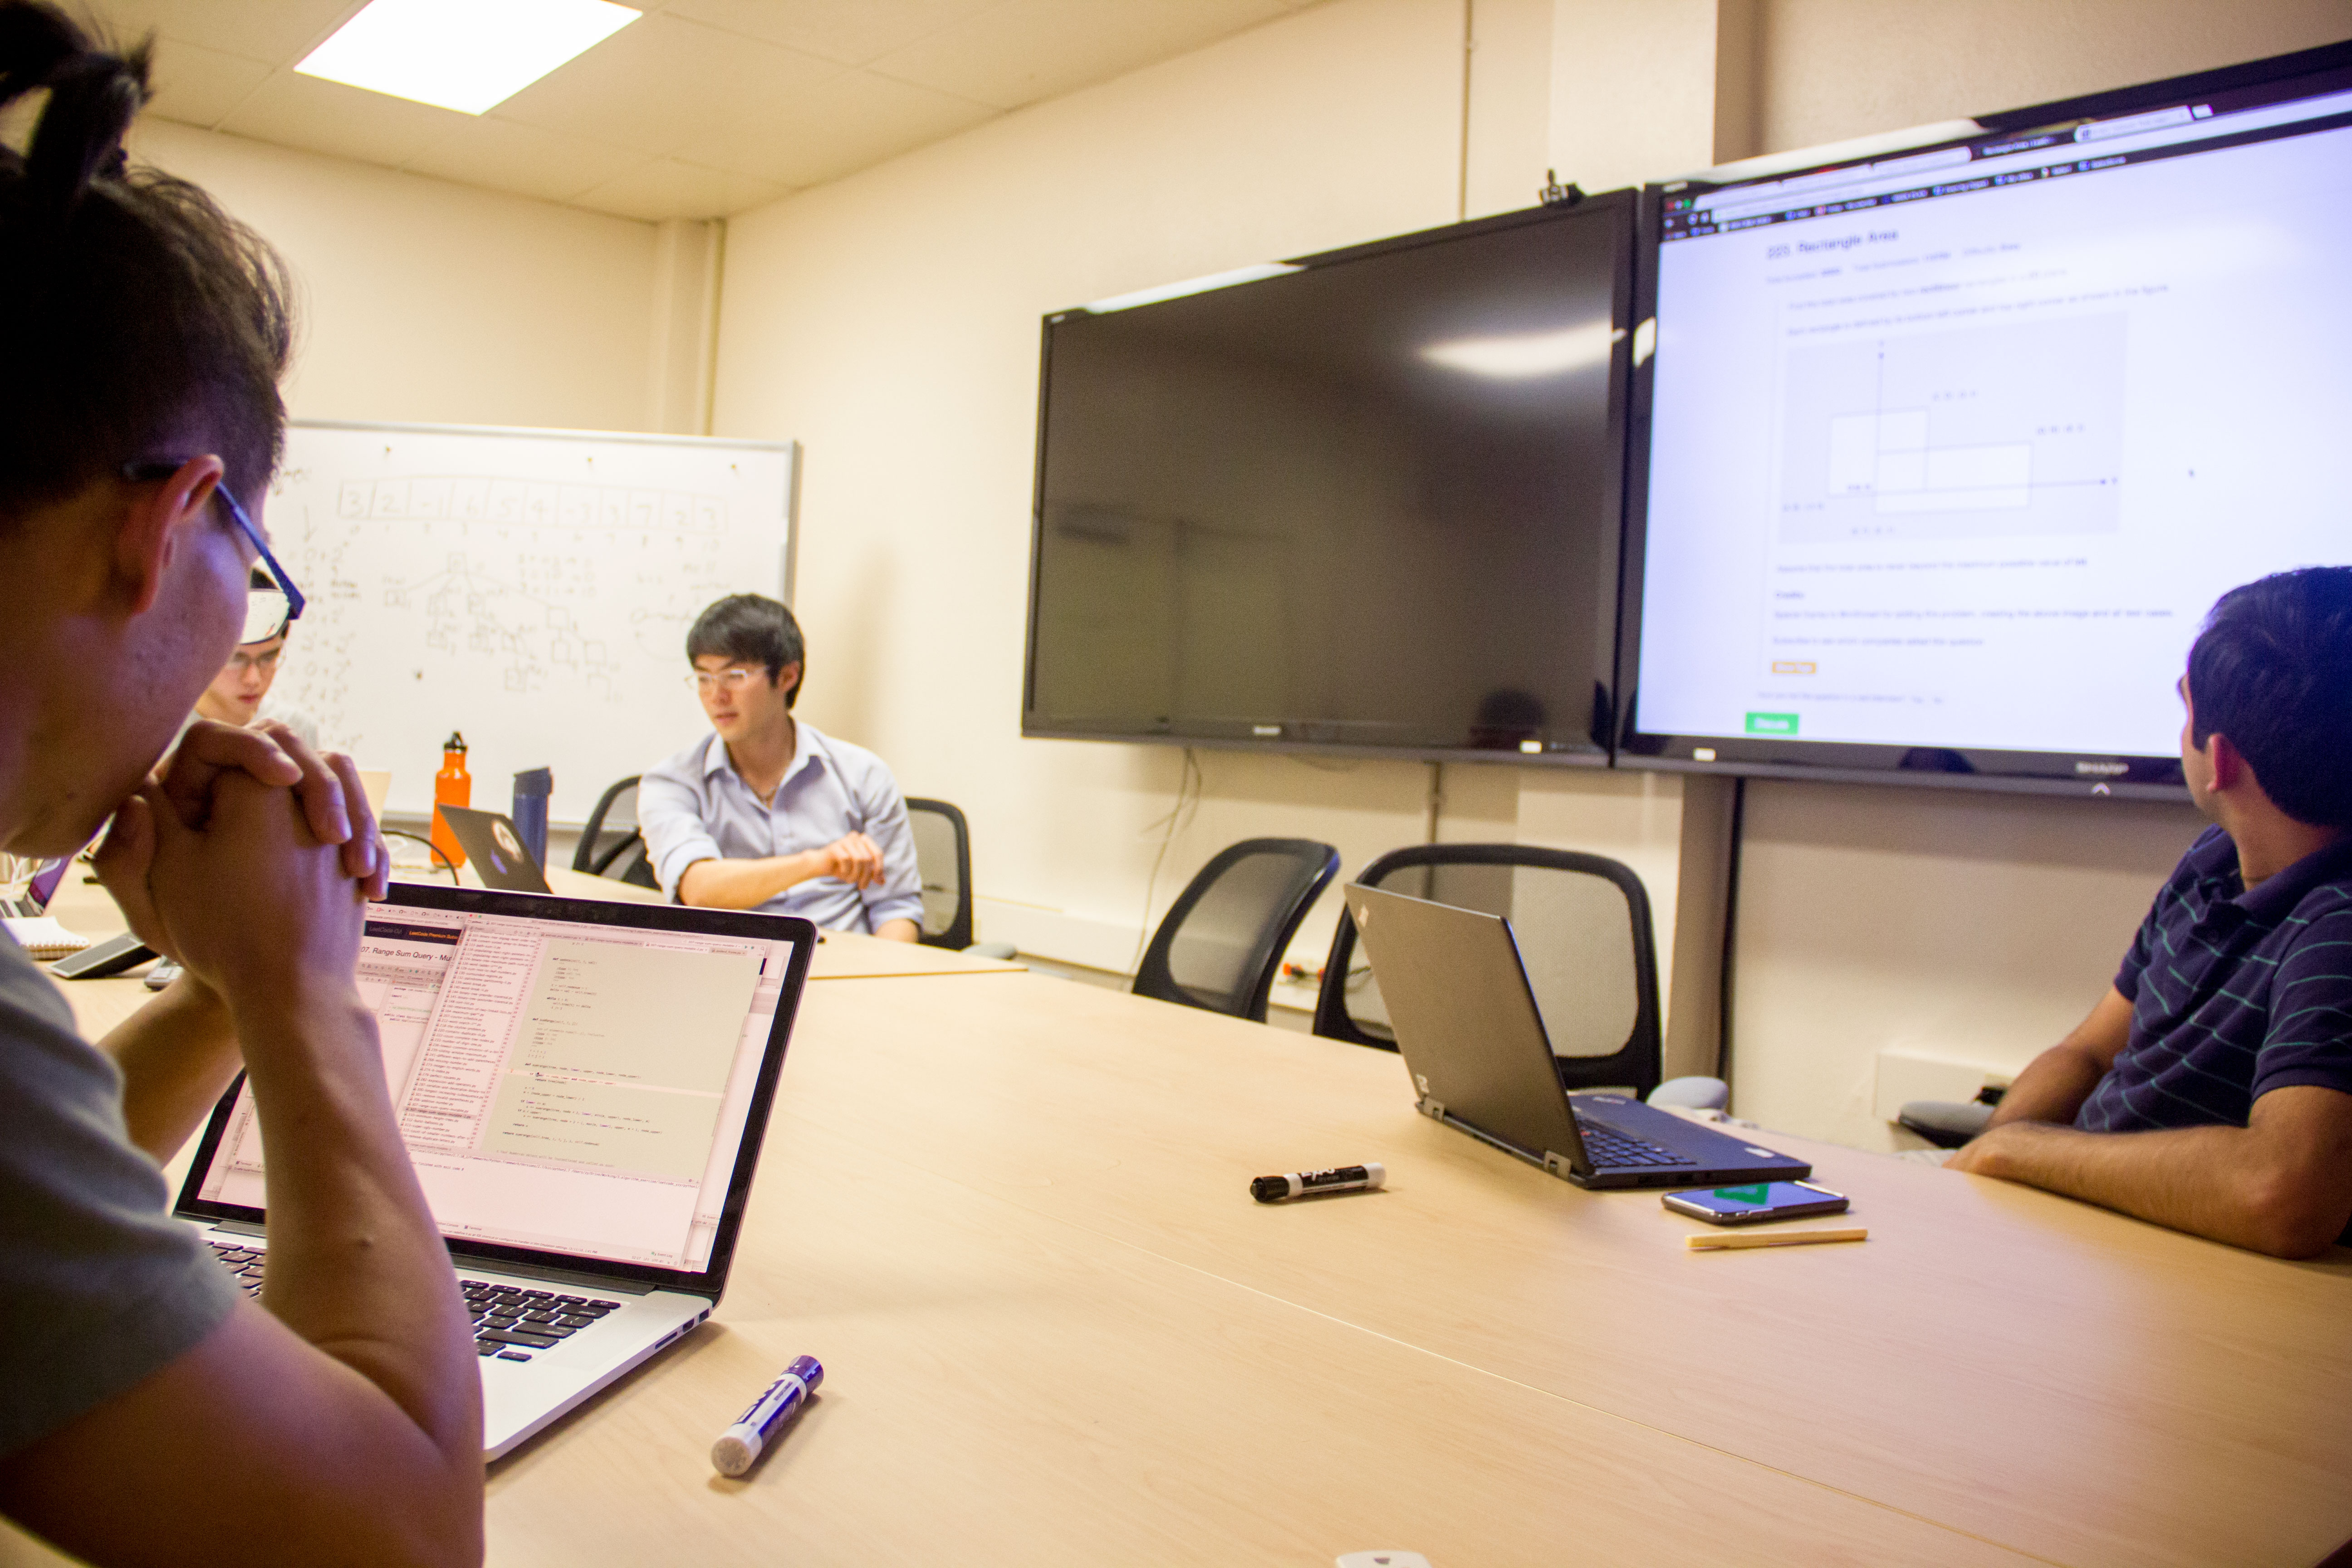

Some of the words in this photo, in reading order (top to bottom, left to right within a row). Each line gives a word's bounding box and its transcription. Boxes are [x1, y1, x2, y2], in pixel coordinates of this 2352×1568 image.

[372, 947, 394, 956] Range
[412, 951, 433, 960] Query
[402, 1134, 455, 1143] 16-remove-duplicate-letters.py
